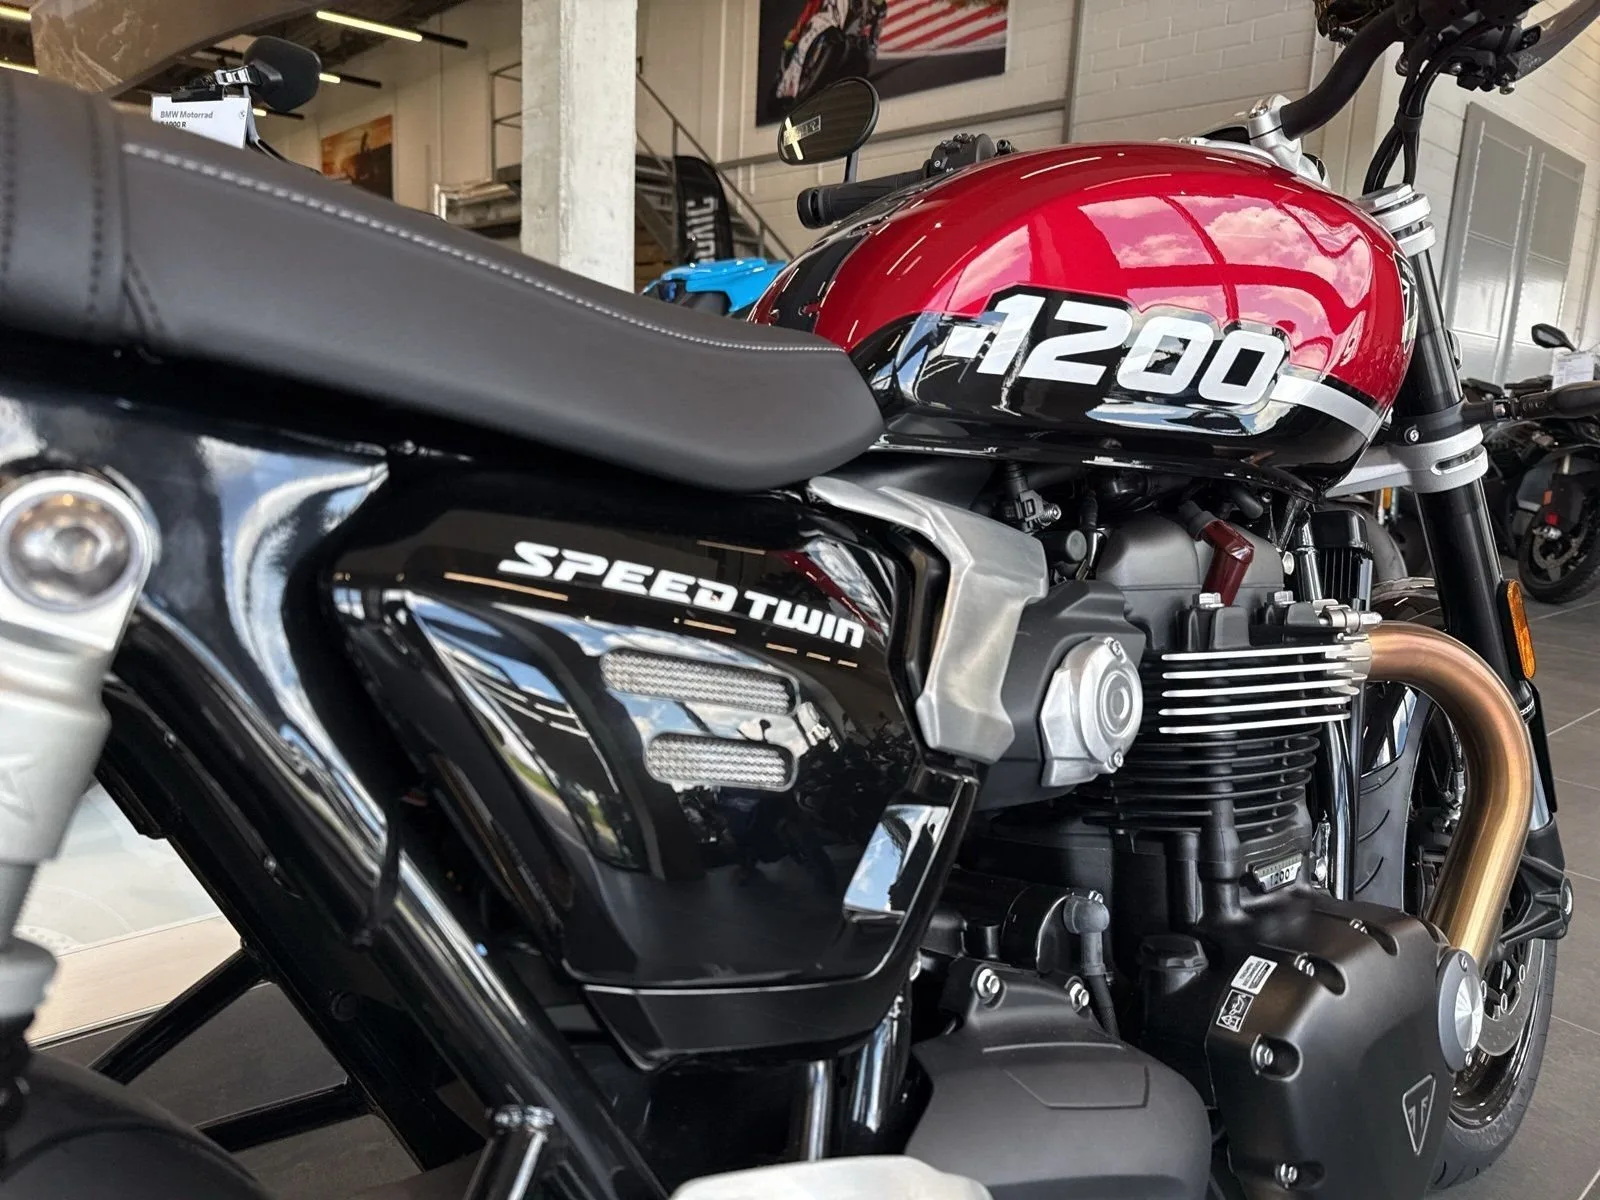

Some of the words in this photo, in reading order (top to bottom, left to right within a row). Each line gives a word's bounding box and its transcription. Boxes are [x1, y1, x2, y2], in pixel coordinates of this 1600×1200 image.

[977, 293, 1286, 405] 1200
[497, 540, 738, 612] SPEED
[744, 590, 865, 649] TWIN
